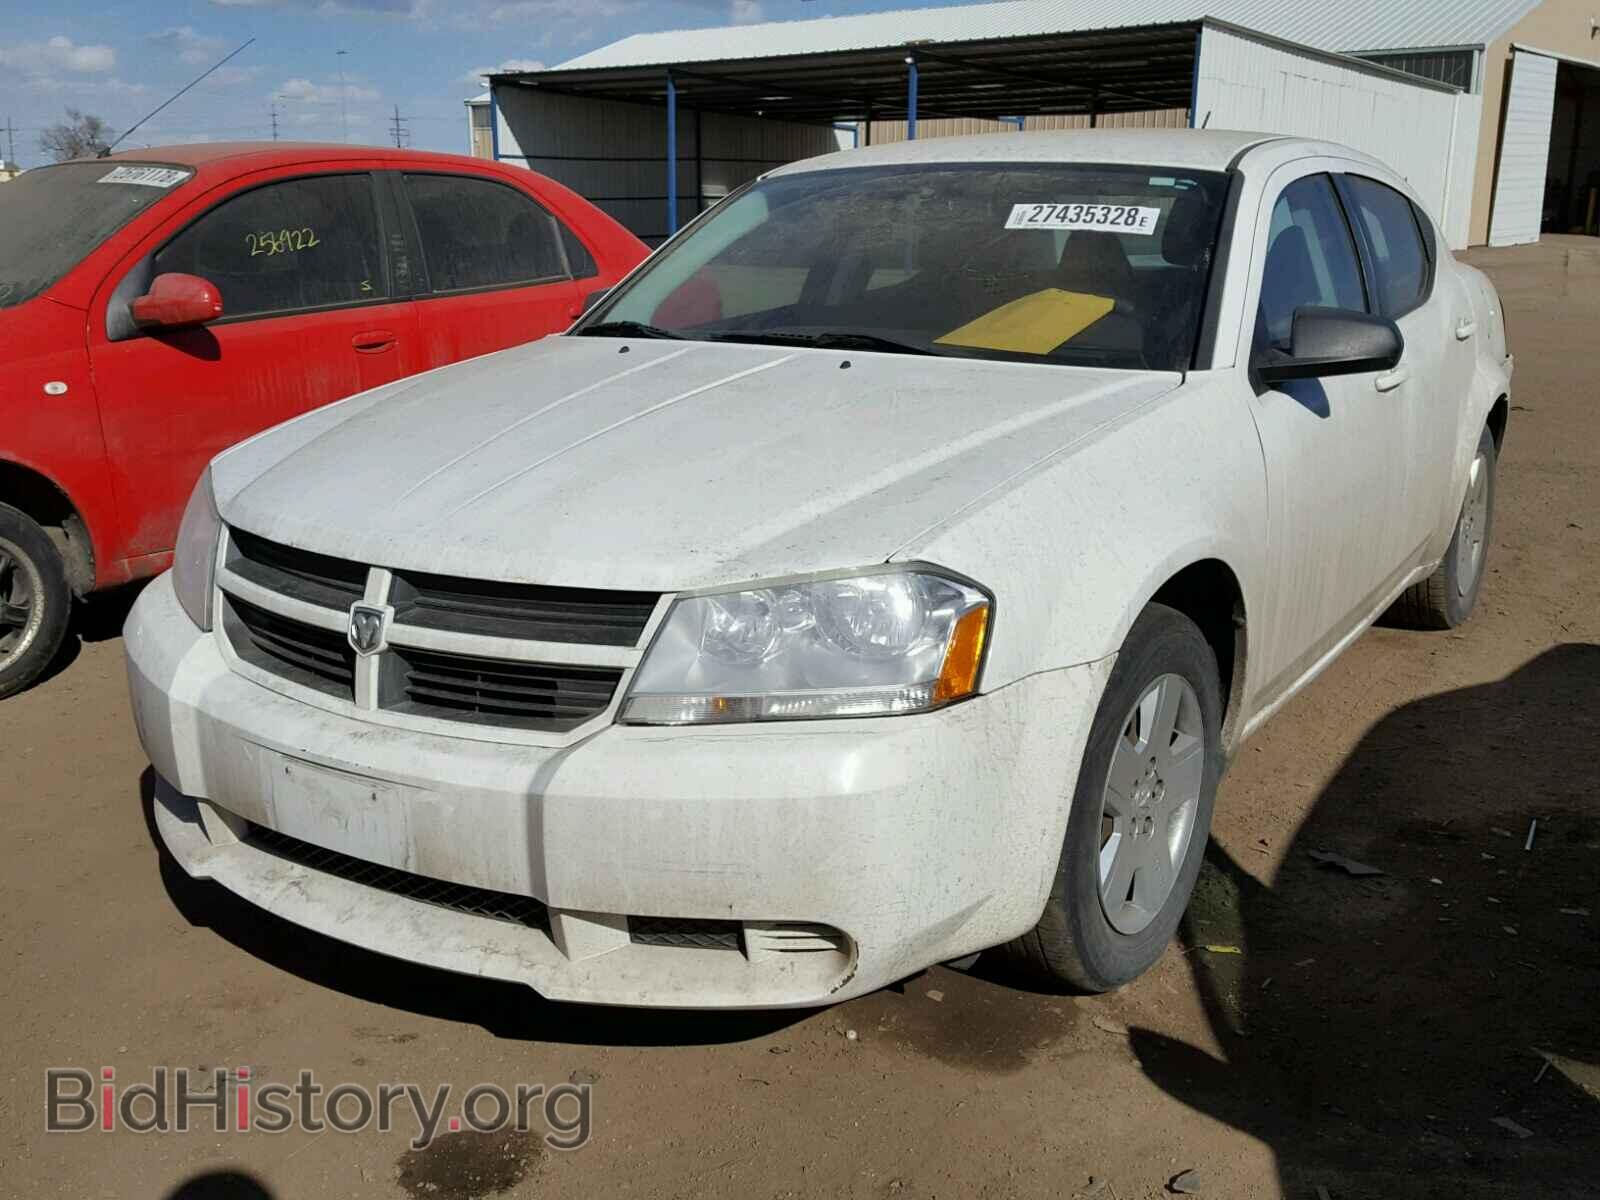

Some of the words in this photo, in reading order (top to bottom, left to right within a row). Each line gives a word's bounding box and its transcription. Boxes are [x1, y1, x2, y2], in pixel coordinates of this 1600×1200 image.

[1028, 205, 1139, 226] 27435328
[1140, 216, 1148, 227] E
[245, 228, 320, 256] 256922
